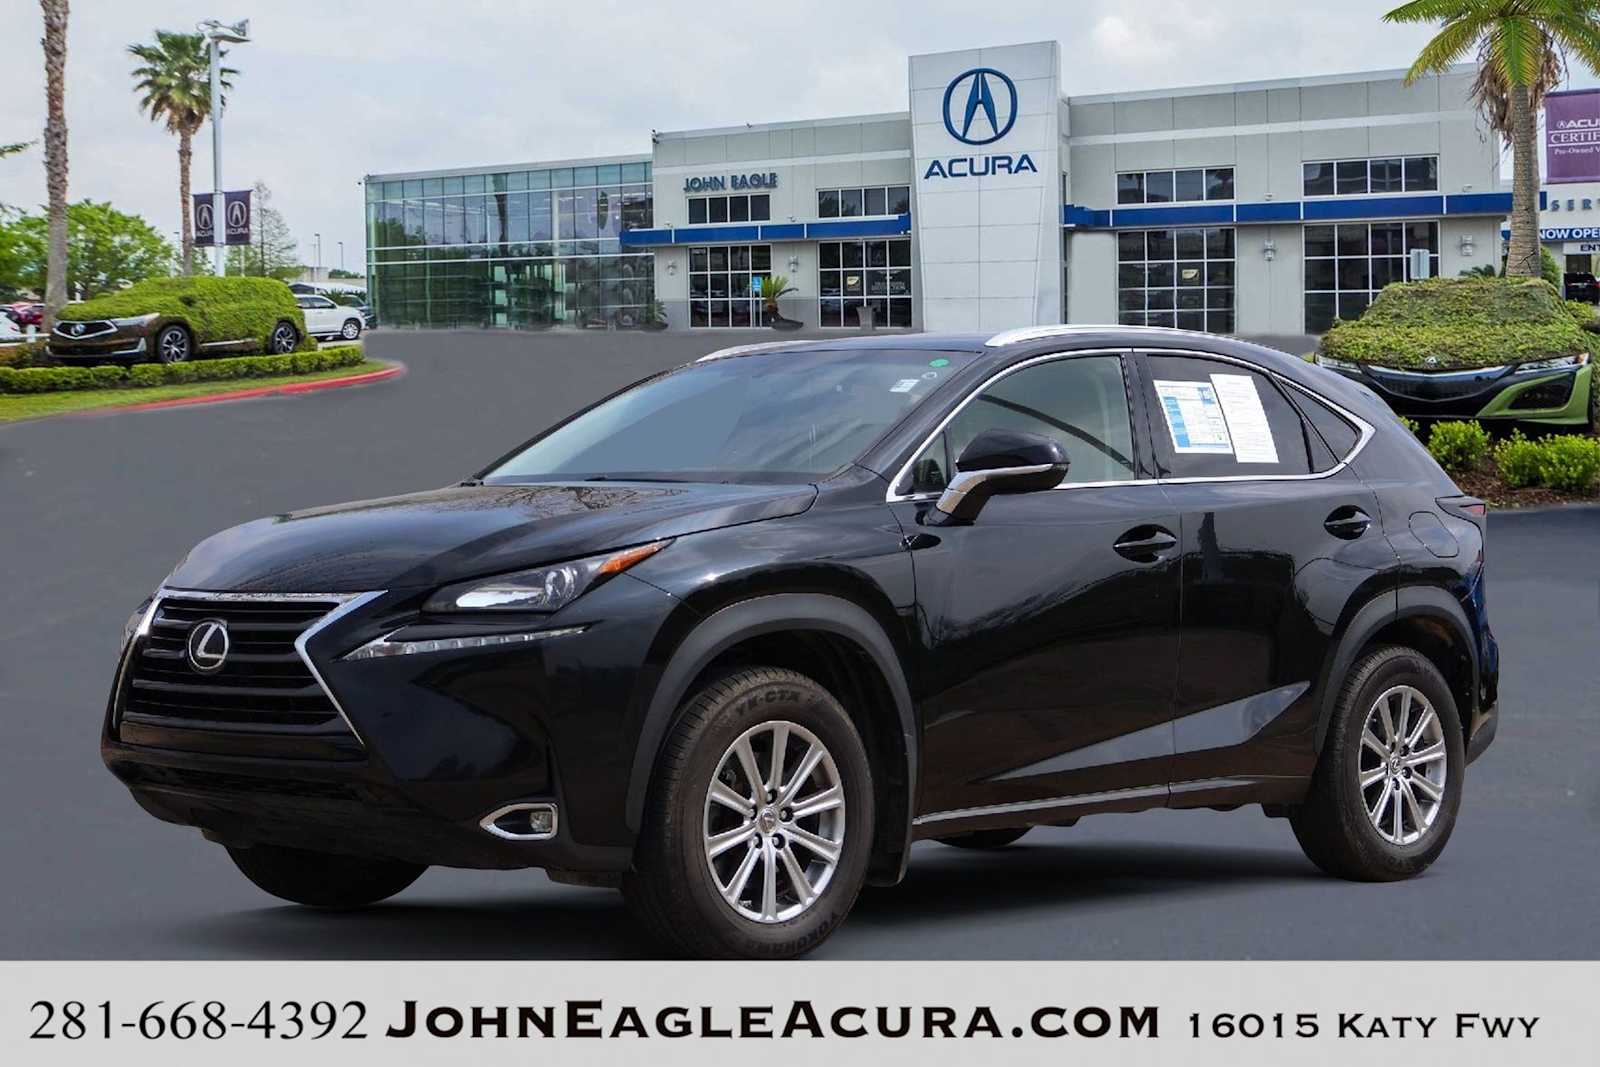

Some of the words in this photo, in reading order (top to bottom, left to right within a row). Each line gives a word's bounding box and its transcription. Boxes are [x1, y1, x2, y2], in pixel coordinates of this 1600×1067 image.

[1566, 119, 1600, 128] ACU
[924, 154, 1037, 179] ACURA
[683, 176, 726, 192] JOHN
[731, 172, 777, 190] EAGLE
[1540, 229, 1569, 239] NOW
[1572, 228, 1600, 239] OPE
